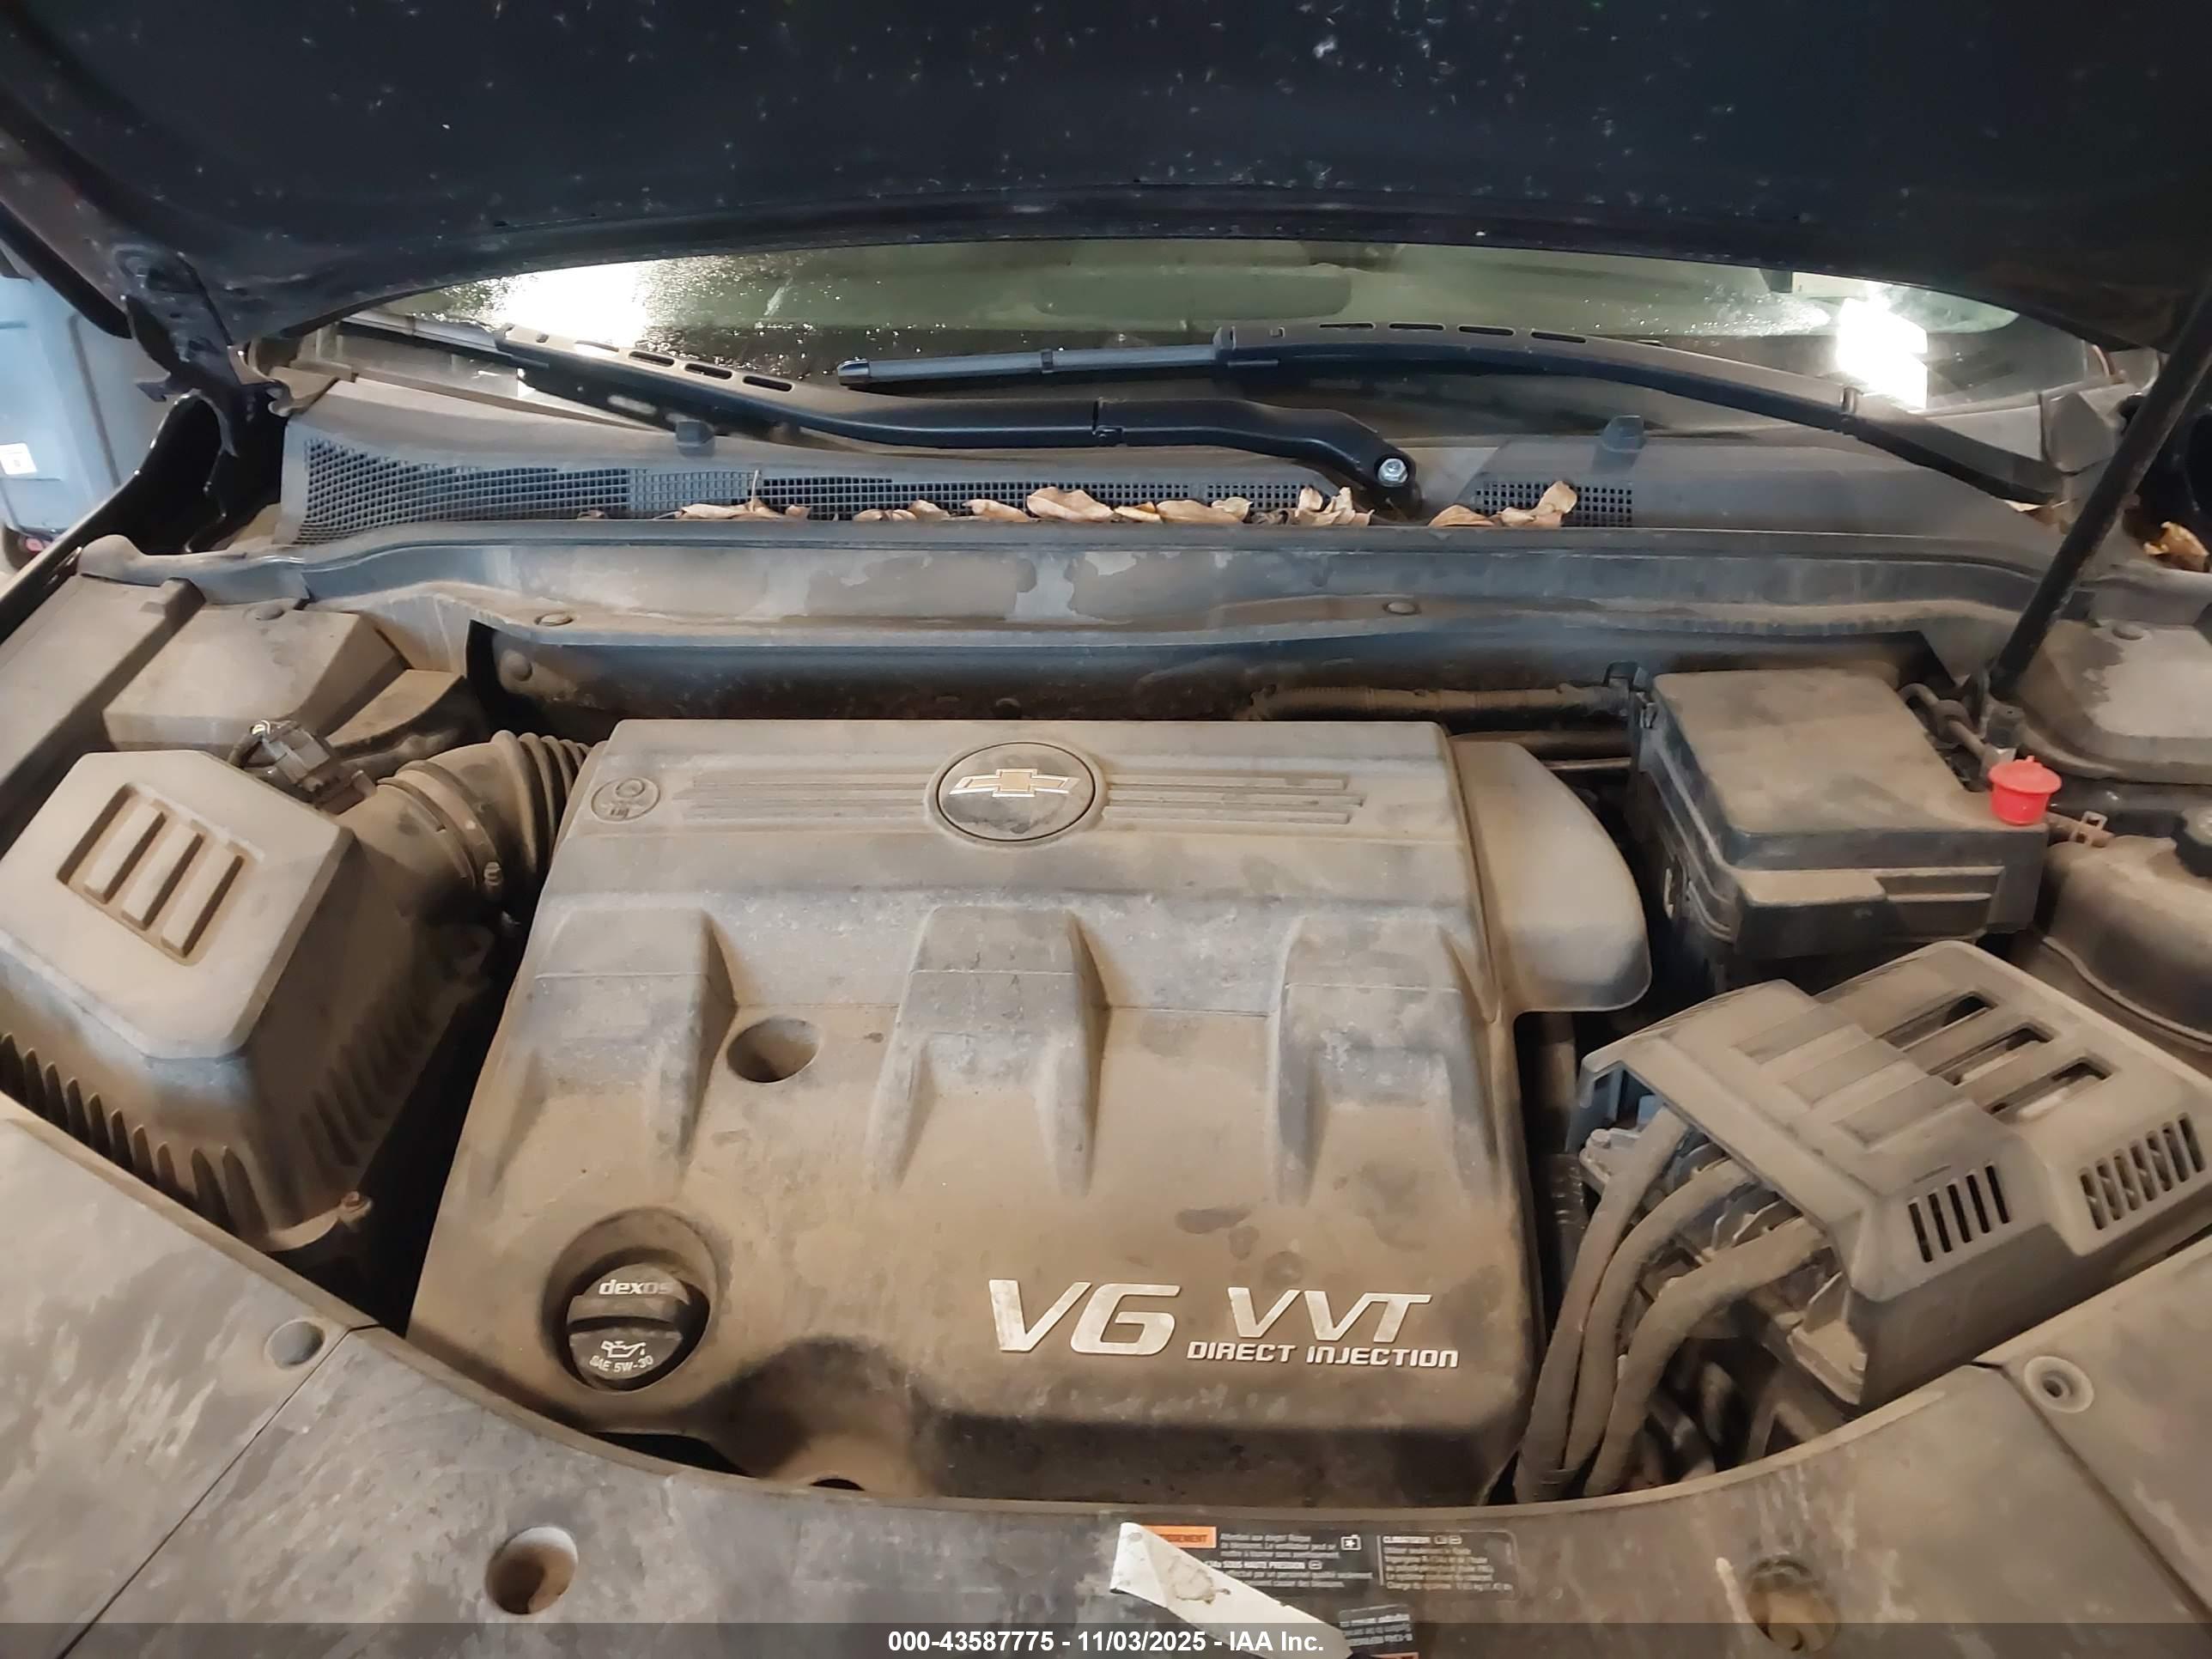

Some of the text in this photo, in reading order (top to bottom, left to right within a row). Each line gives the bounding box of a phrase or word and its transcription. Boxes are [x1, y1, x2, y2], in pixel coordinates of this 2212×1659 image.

[599, 1279, 673, 1295] dexos
[988, 1279, 1432, 1356] V6 VVT
[589, 1355, 653, 1372] SAE 5W-30
[1187, 1341, 1459, 1369] DIRECT INJECTION
